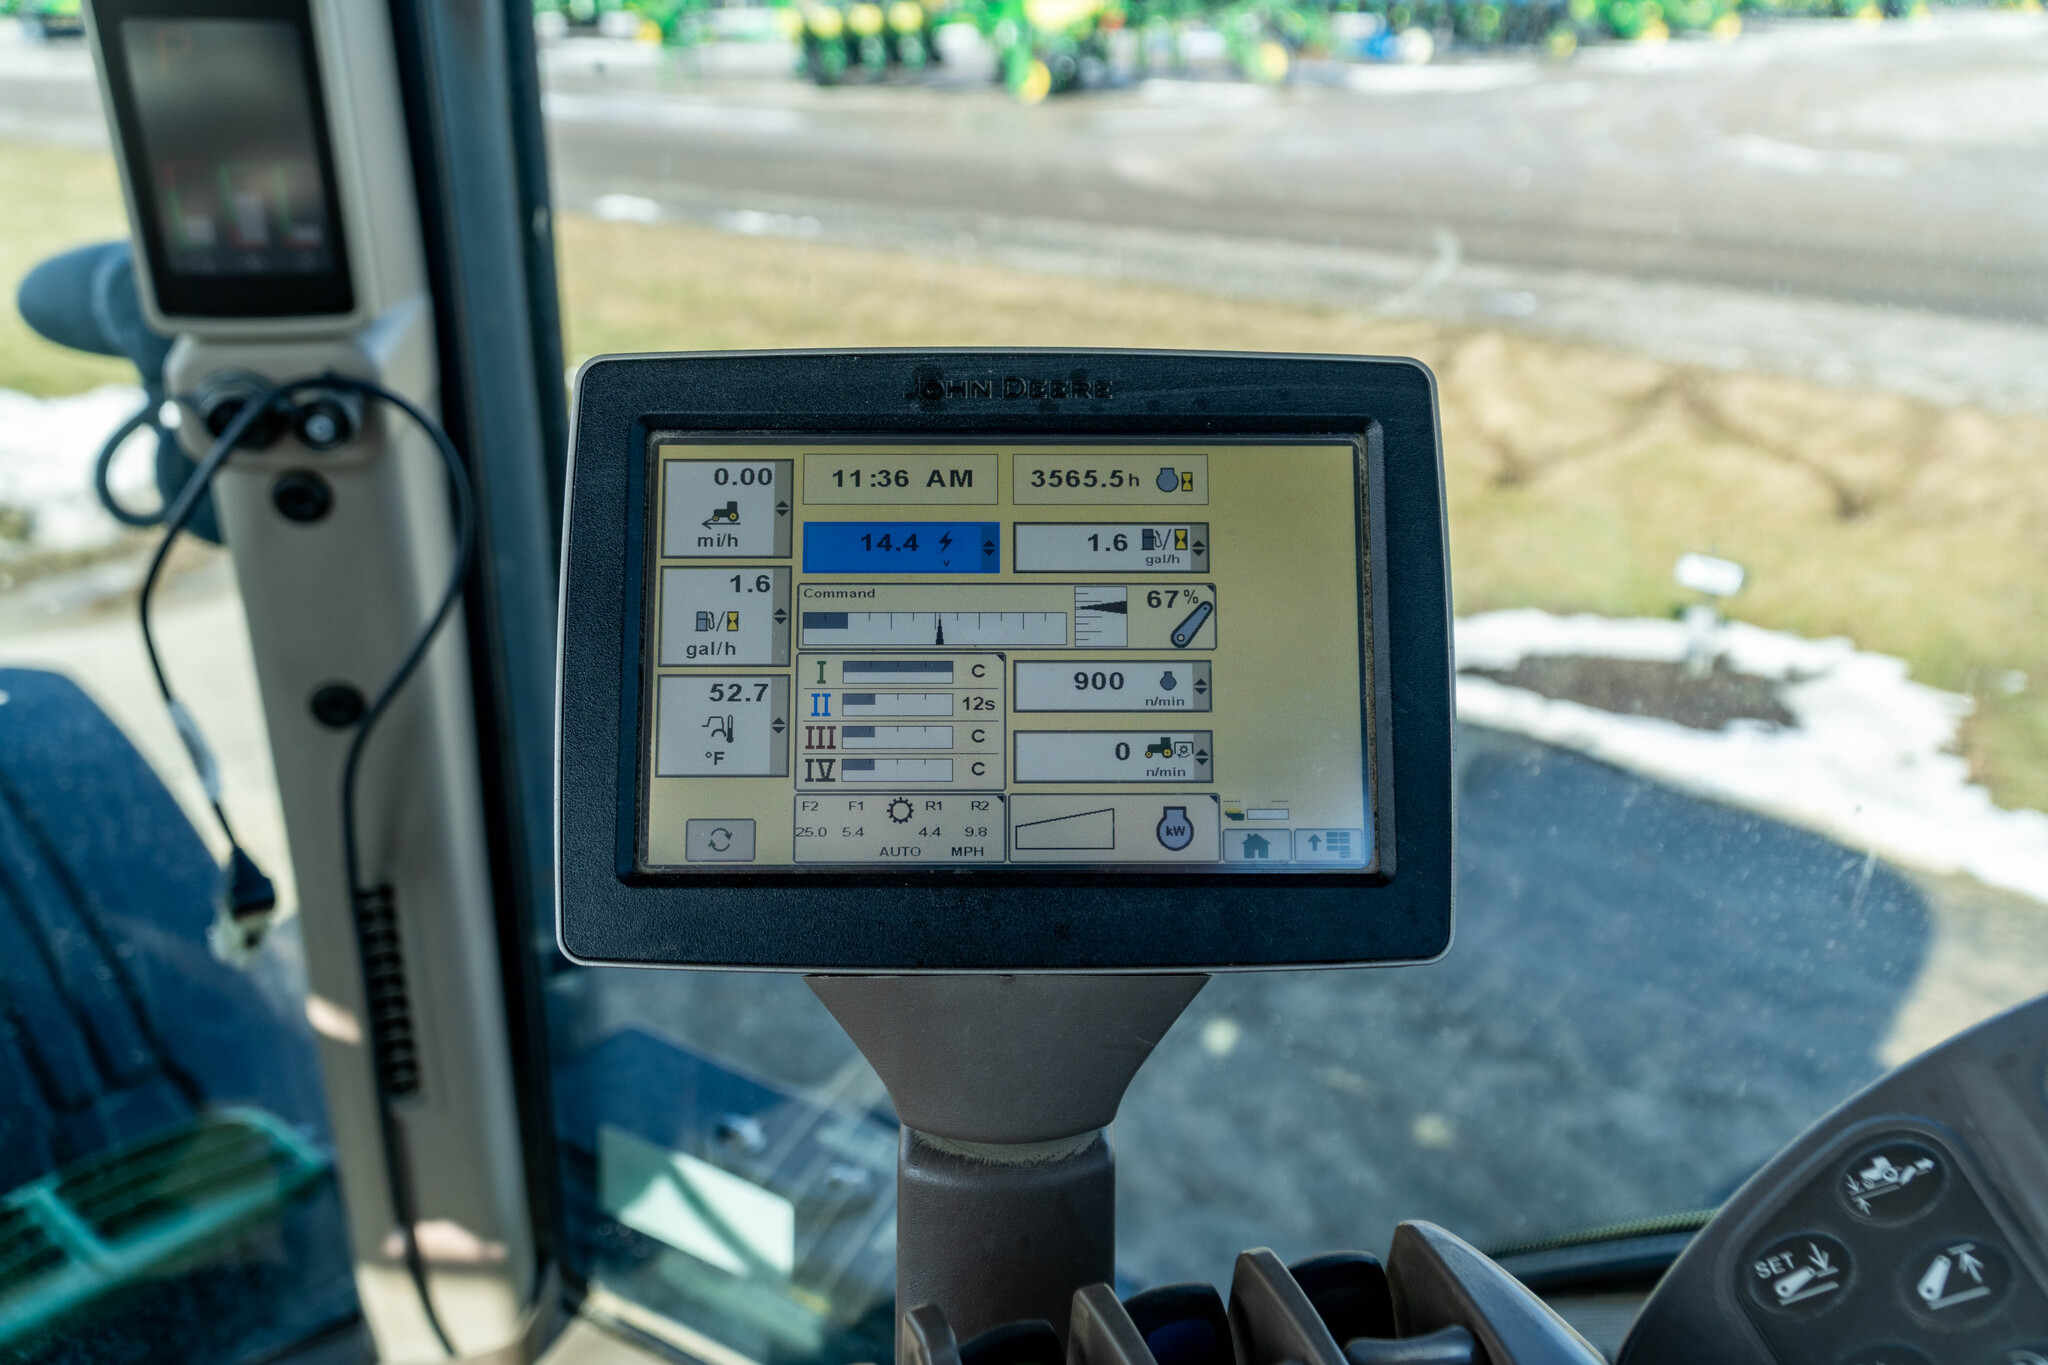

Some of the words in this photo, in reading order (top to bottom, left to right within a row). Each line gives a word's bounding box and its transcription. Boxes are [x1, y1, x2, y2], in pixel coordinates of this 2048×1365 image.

[904, 375, 992, 399] JOHN
[1001, 375, 1113, 399] DEERE
[714, 467, 773, 486] 0.00
[832, 469, 909, 488] 11:36
[926, 469, 973, 488] AM
[697, 533, 739, 548] mi/h
[861, 533, 919, 551] 14.4
[1087, 533, 1128, 552] 1.6
[1145, 554, 1180, 567] gal/h
[730, 574, 771, 593] 1.6
[803, 588, 876, 598] Command
[686, 641, 736, 659] gal/h
[971, 664, 985, 678] C
[1074, 671, 1124, 690] 900
[709, 683, 769, 702] 52.7
[810, 693, 831, 717] II
[962, 696, 996, 711] 12s
[1145, 696, 1185, 706] n/min
[805, 726, 836, 749] III
[971, 729, 985, 743] C
[705, 751, 725, 765] °F
[1115, 742, 1131, 760] 0
[804, 759, 836, 782] IV
[971, 762, 985, 776] C
[1146, 767, 1186, 777] n/min
[802, 801, 819, 811] F2
[848, 801, 864, 811] F1
[925, 801, 942, 811] R1
[971, 801, 989, 811] R2
[795, 827, 827, 837] 25.0
[842, 827, 864, 837] 5.4
[918, 827, 941, 837] 4.4
[965, 827, 988, 837] 9.8
[1165, 825, 1186, 837] kW
[879, 847, 921, 857] AUTO
[951, 847, 984, 857] MPH
[1754, 1251, 1795, 1280] SET
